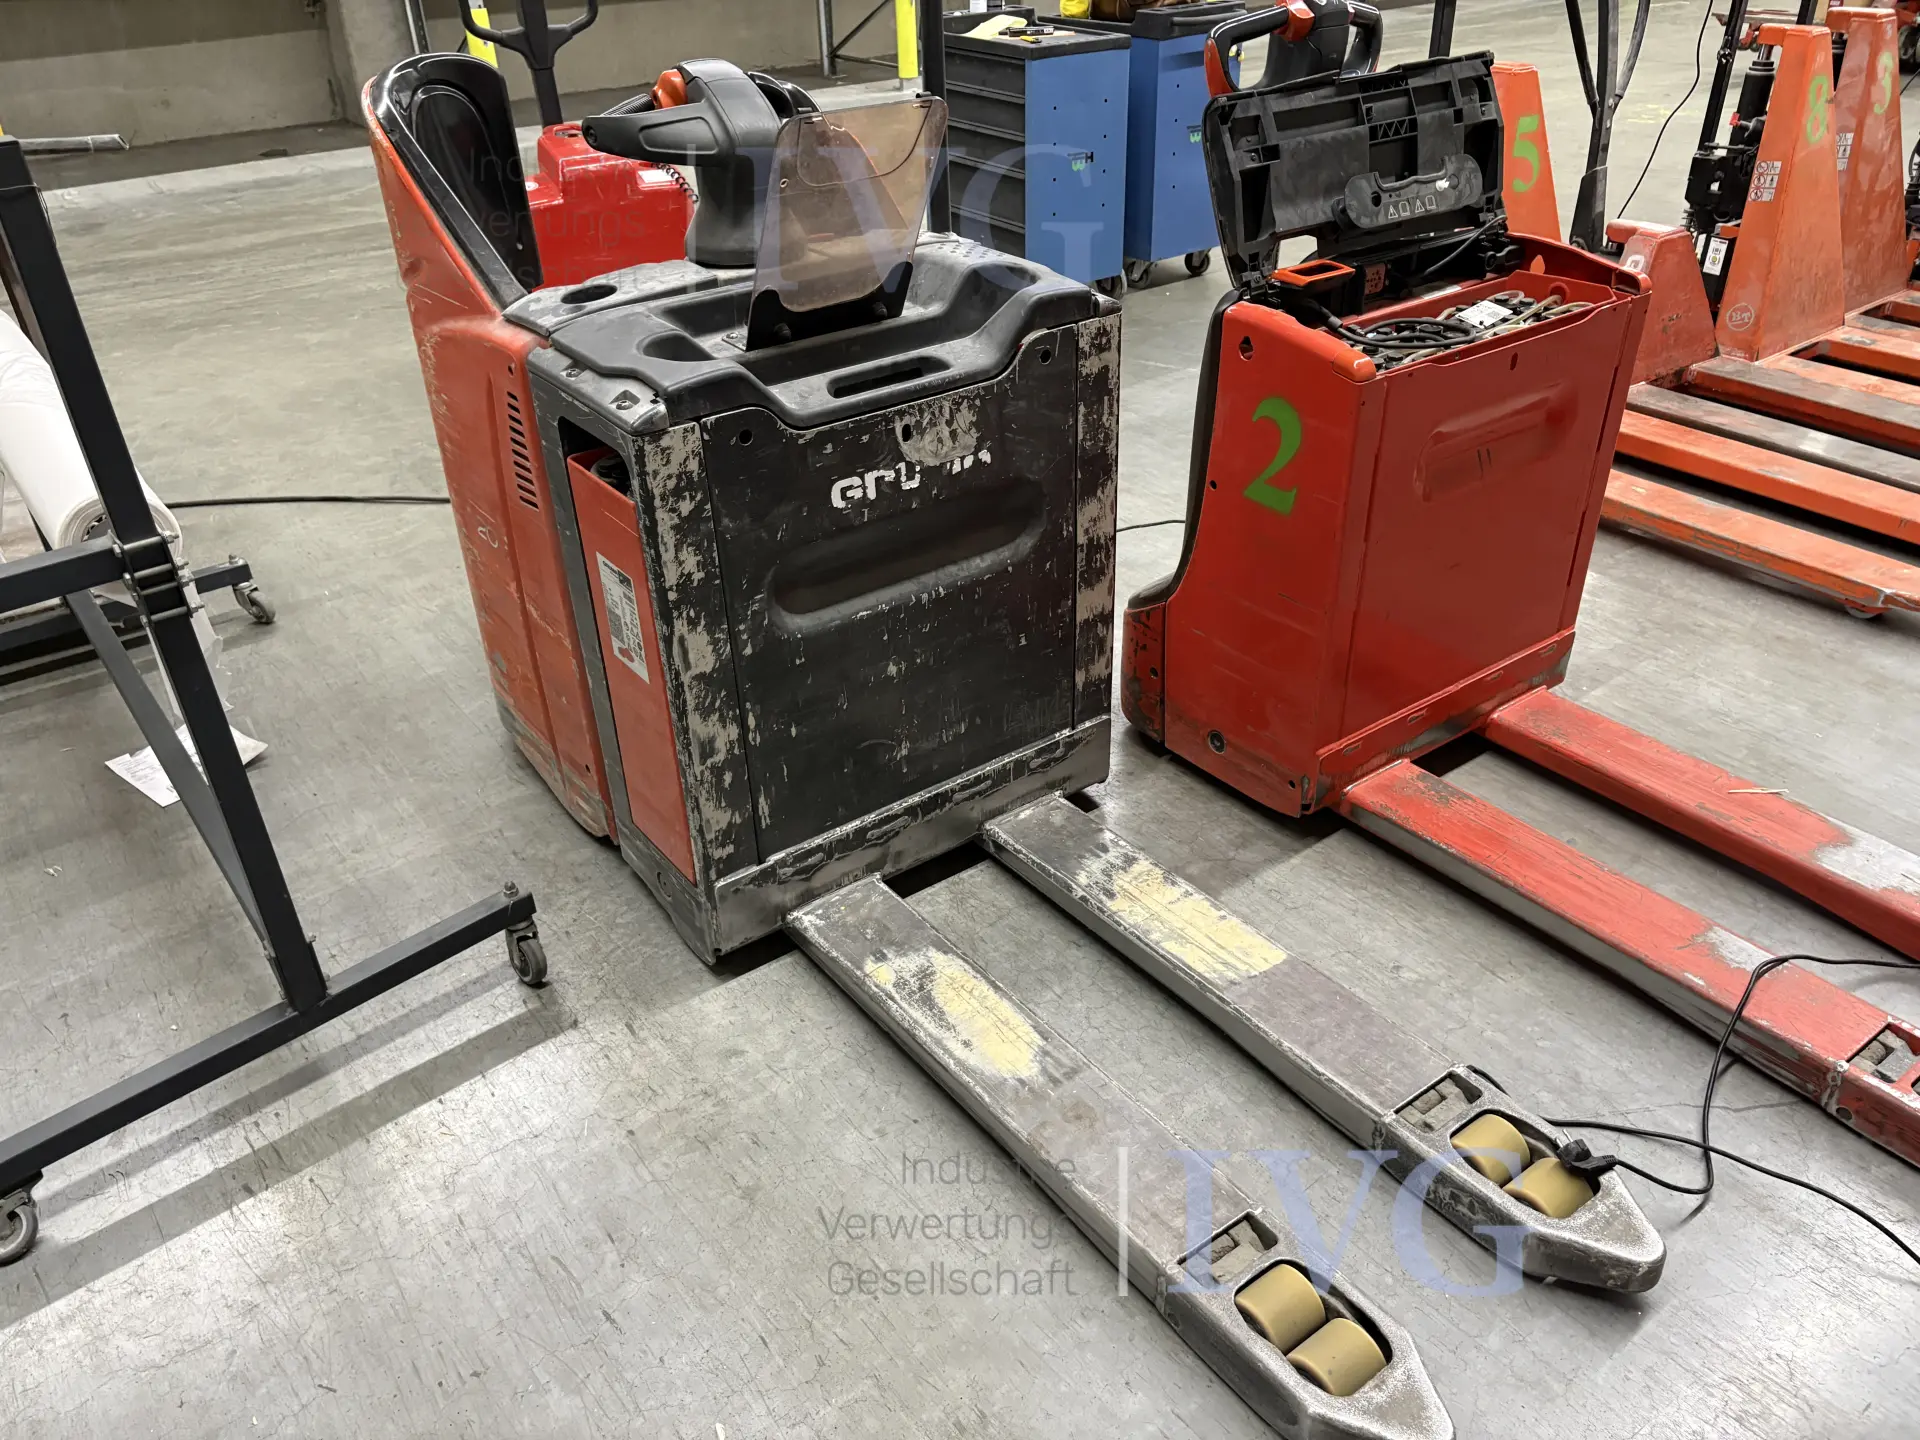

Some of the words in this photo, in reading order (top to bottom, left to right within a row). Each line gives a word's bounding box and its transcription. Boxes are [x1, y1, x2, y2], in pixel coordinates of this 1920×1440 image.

[1806, 76, 1828, 143] 8
[1874, 52, 1893, 114] 3
[1511, 114, 1541, 193] 5
[1242, 396, 1302, 515] 2
